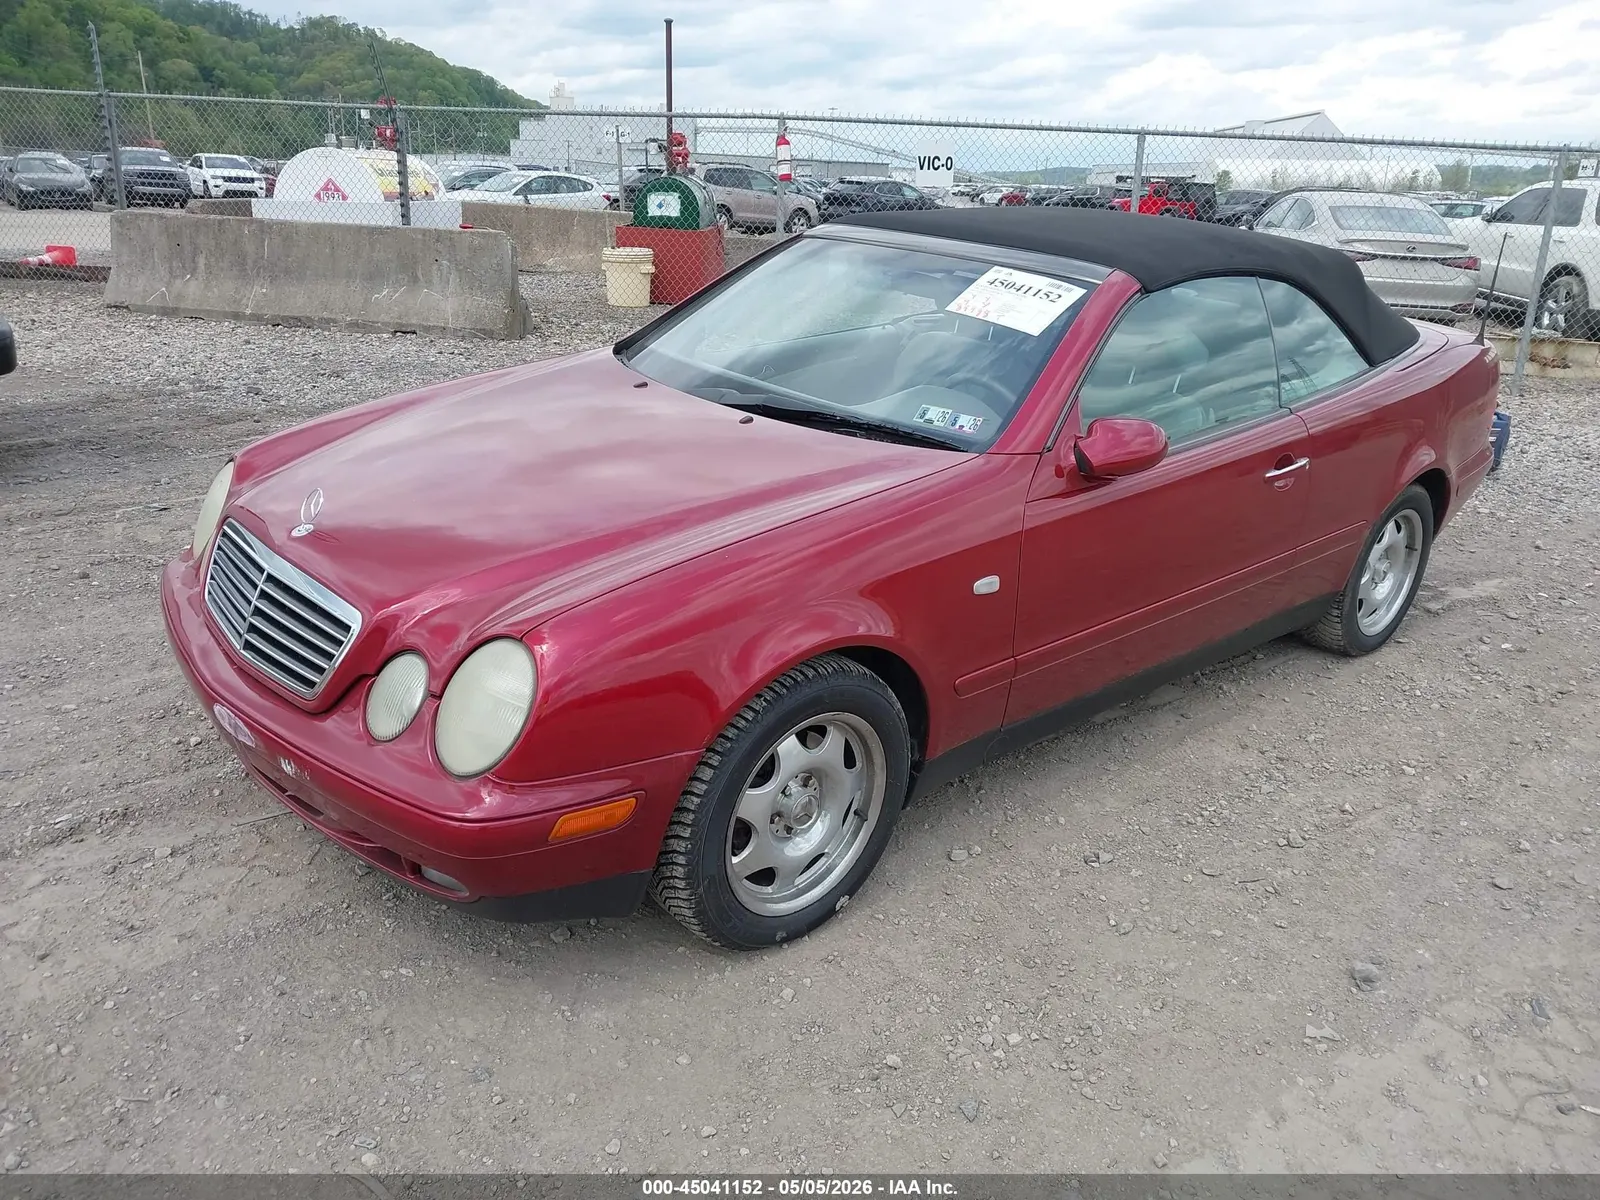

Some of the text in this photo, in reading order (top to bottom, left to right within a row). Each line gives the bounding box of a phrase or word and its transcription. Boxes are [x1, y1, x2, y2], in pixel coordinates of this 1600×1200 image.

[986, 277, 1063, 303] 45041152
[919, 409, 928, 420] 5
[937, 410, 950, 423] 26
[950, 416, 981, 431] 5 26
